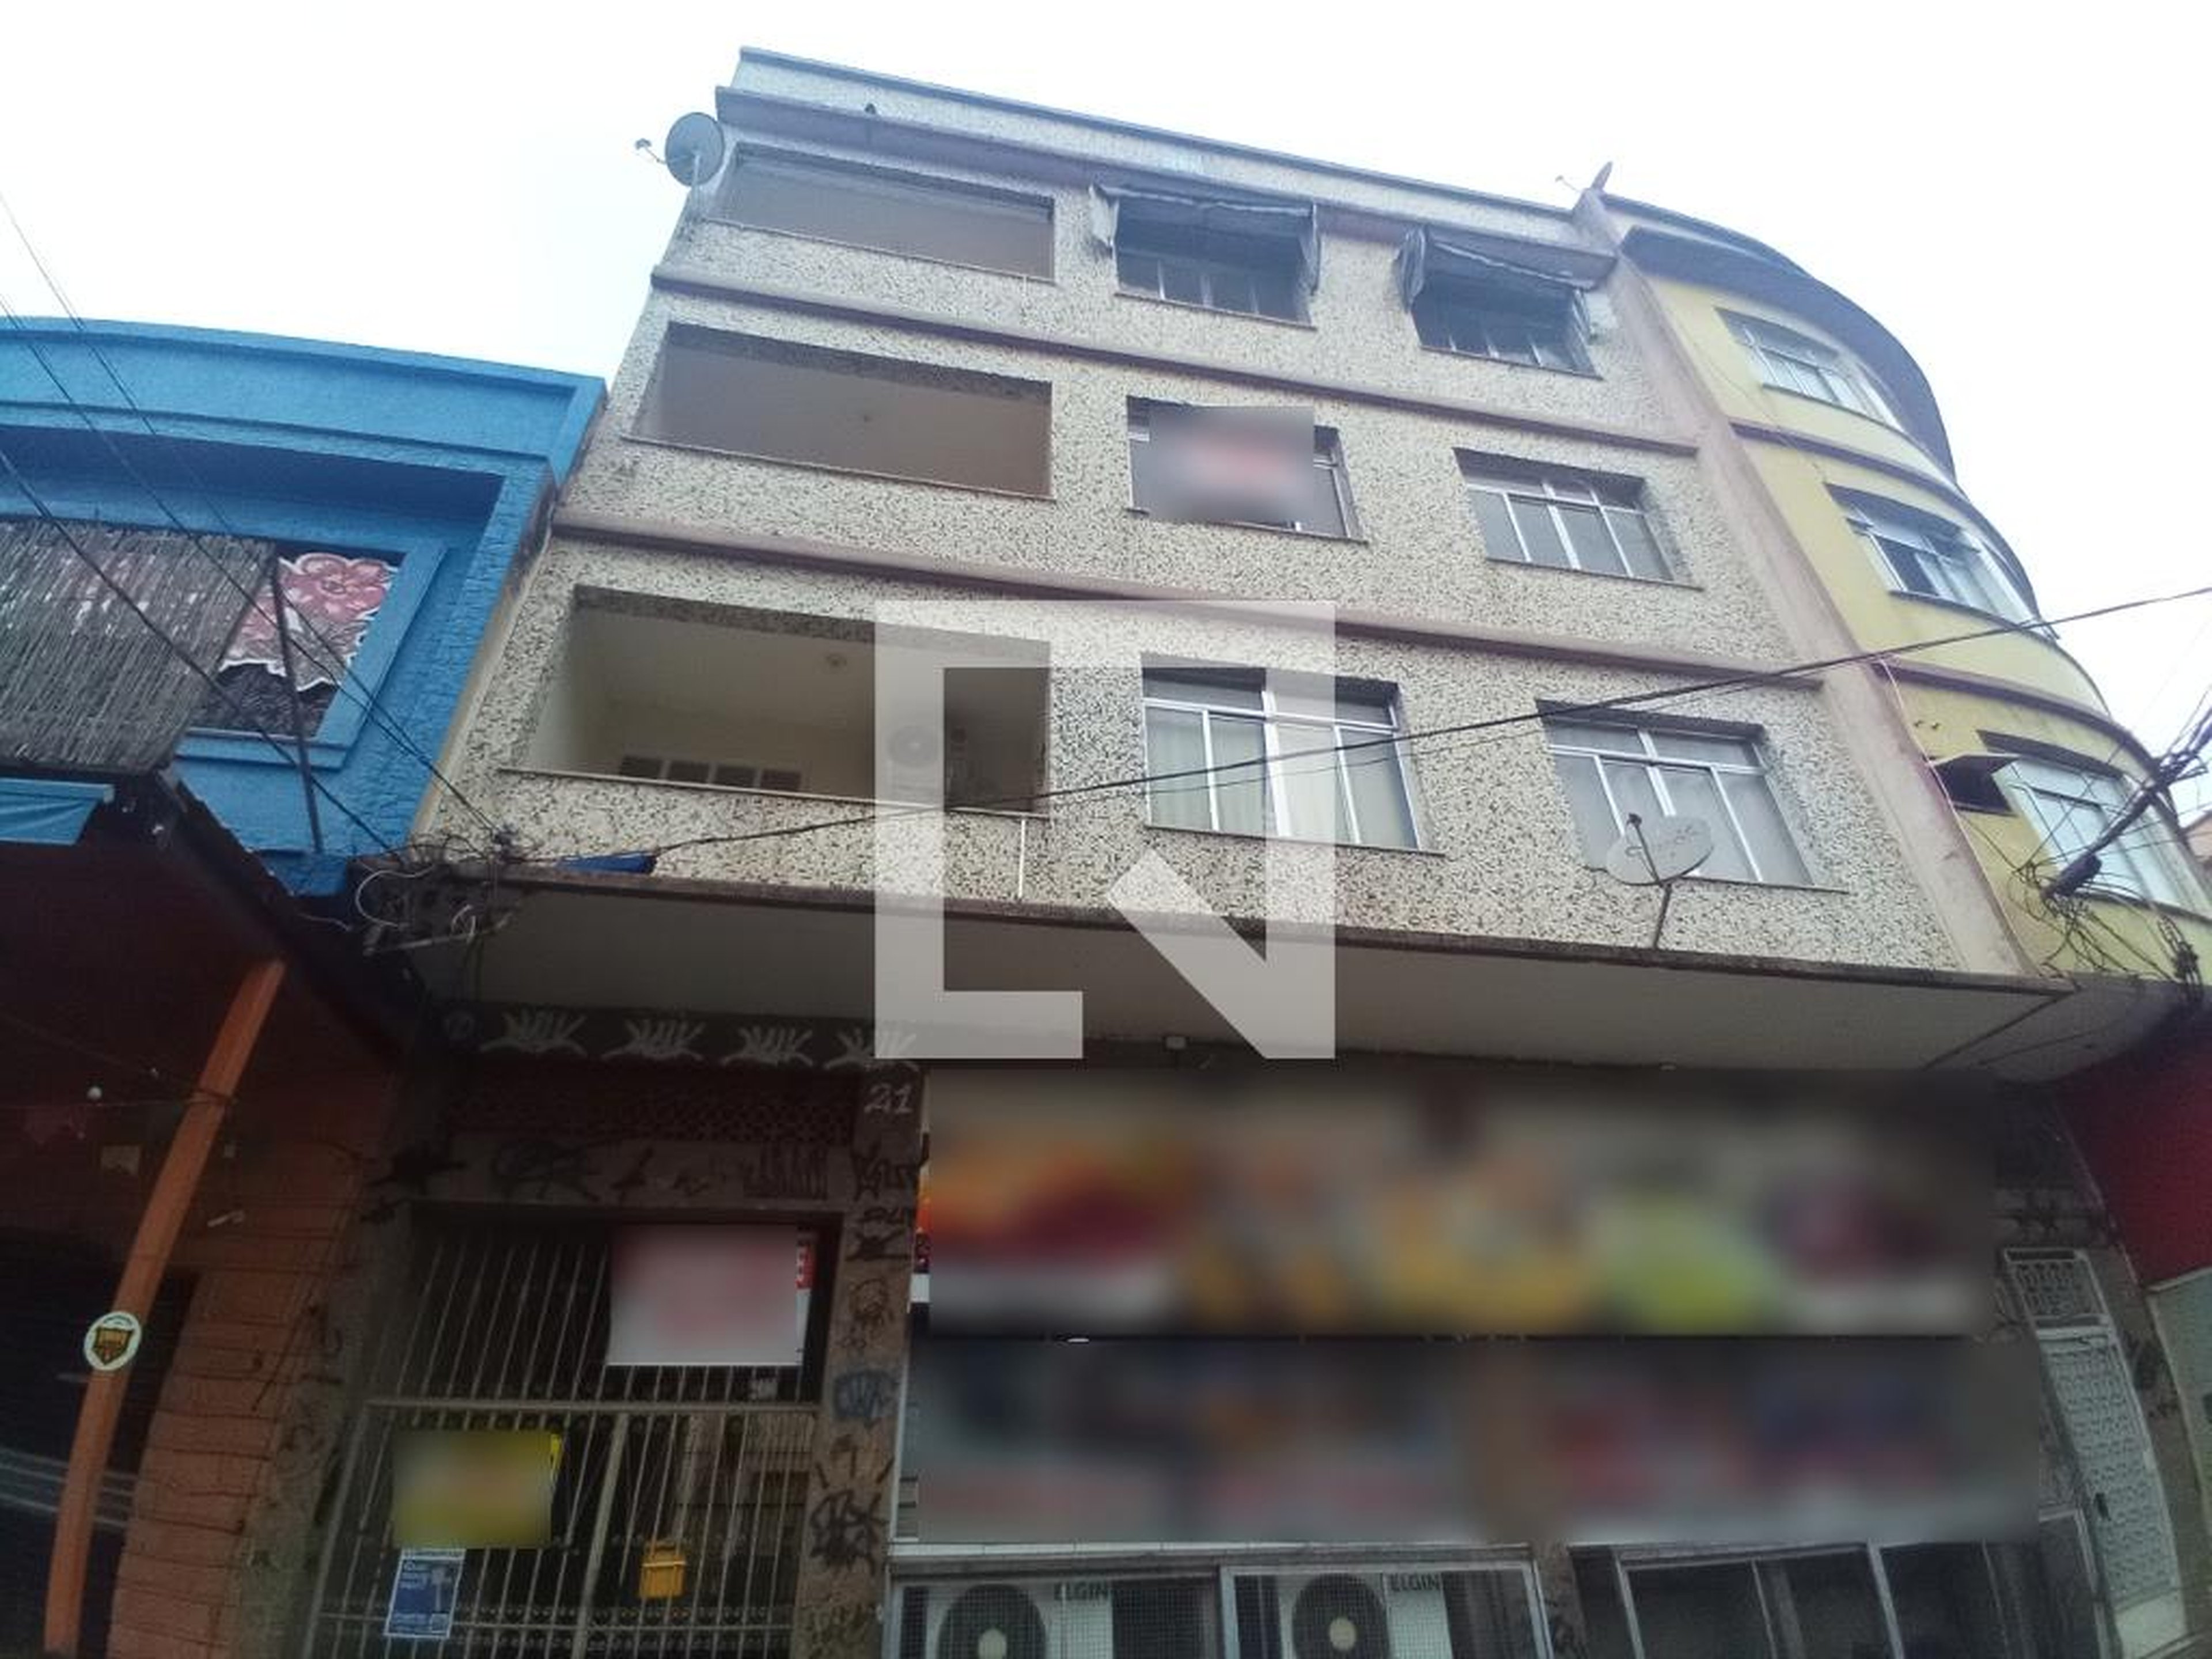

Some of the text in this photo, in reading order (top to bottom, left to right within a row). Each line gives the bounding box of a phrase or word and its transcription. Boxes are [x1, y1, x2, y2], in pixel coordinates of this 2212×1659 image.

[863, 1082, 914, 1114] 21
[1053, 1581, 1108, 1601] ELGIN
[1389, 1573, 1441, 1592] ELGIN
